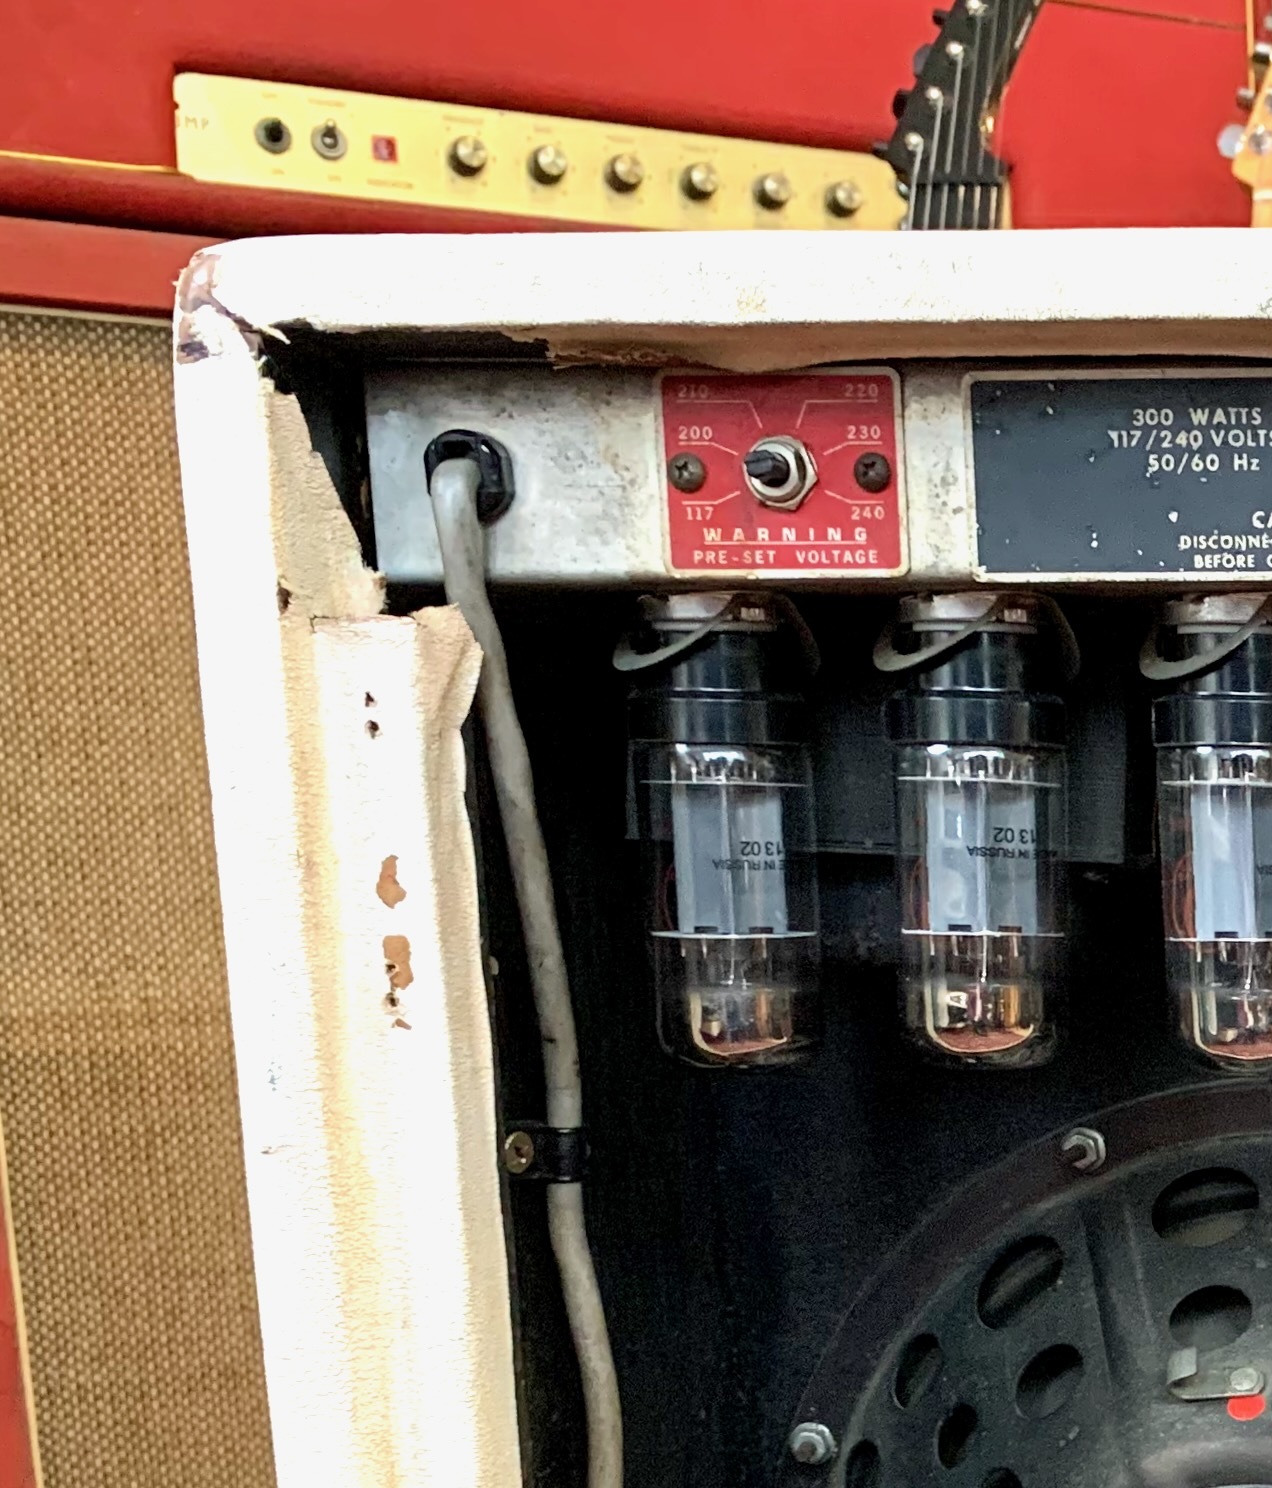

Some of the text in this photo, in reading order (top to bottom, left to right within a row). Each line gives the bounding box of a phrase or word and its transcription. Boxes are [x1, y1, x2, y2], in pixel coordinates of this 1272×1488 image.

[677, 384, 709, 398] 210
[844, 383, 879, 398] 220
[1132, 407, 1262, 427] 300 WATTS
[678, 425, 713, 440] 200
[847, 425, 881, 440] 230
[1147, 453, 1261, 474] 50/60 Hz
[685, 506, 714, 521] 117
[851, 506, 885, 521] 240
[693, 549, 879, 565] PRE-SET VOLTAGE
[1193, 554, 1256, 569] BEFORE
[966, 844, 1015, 859] RUSSIA
